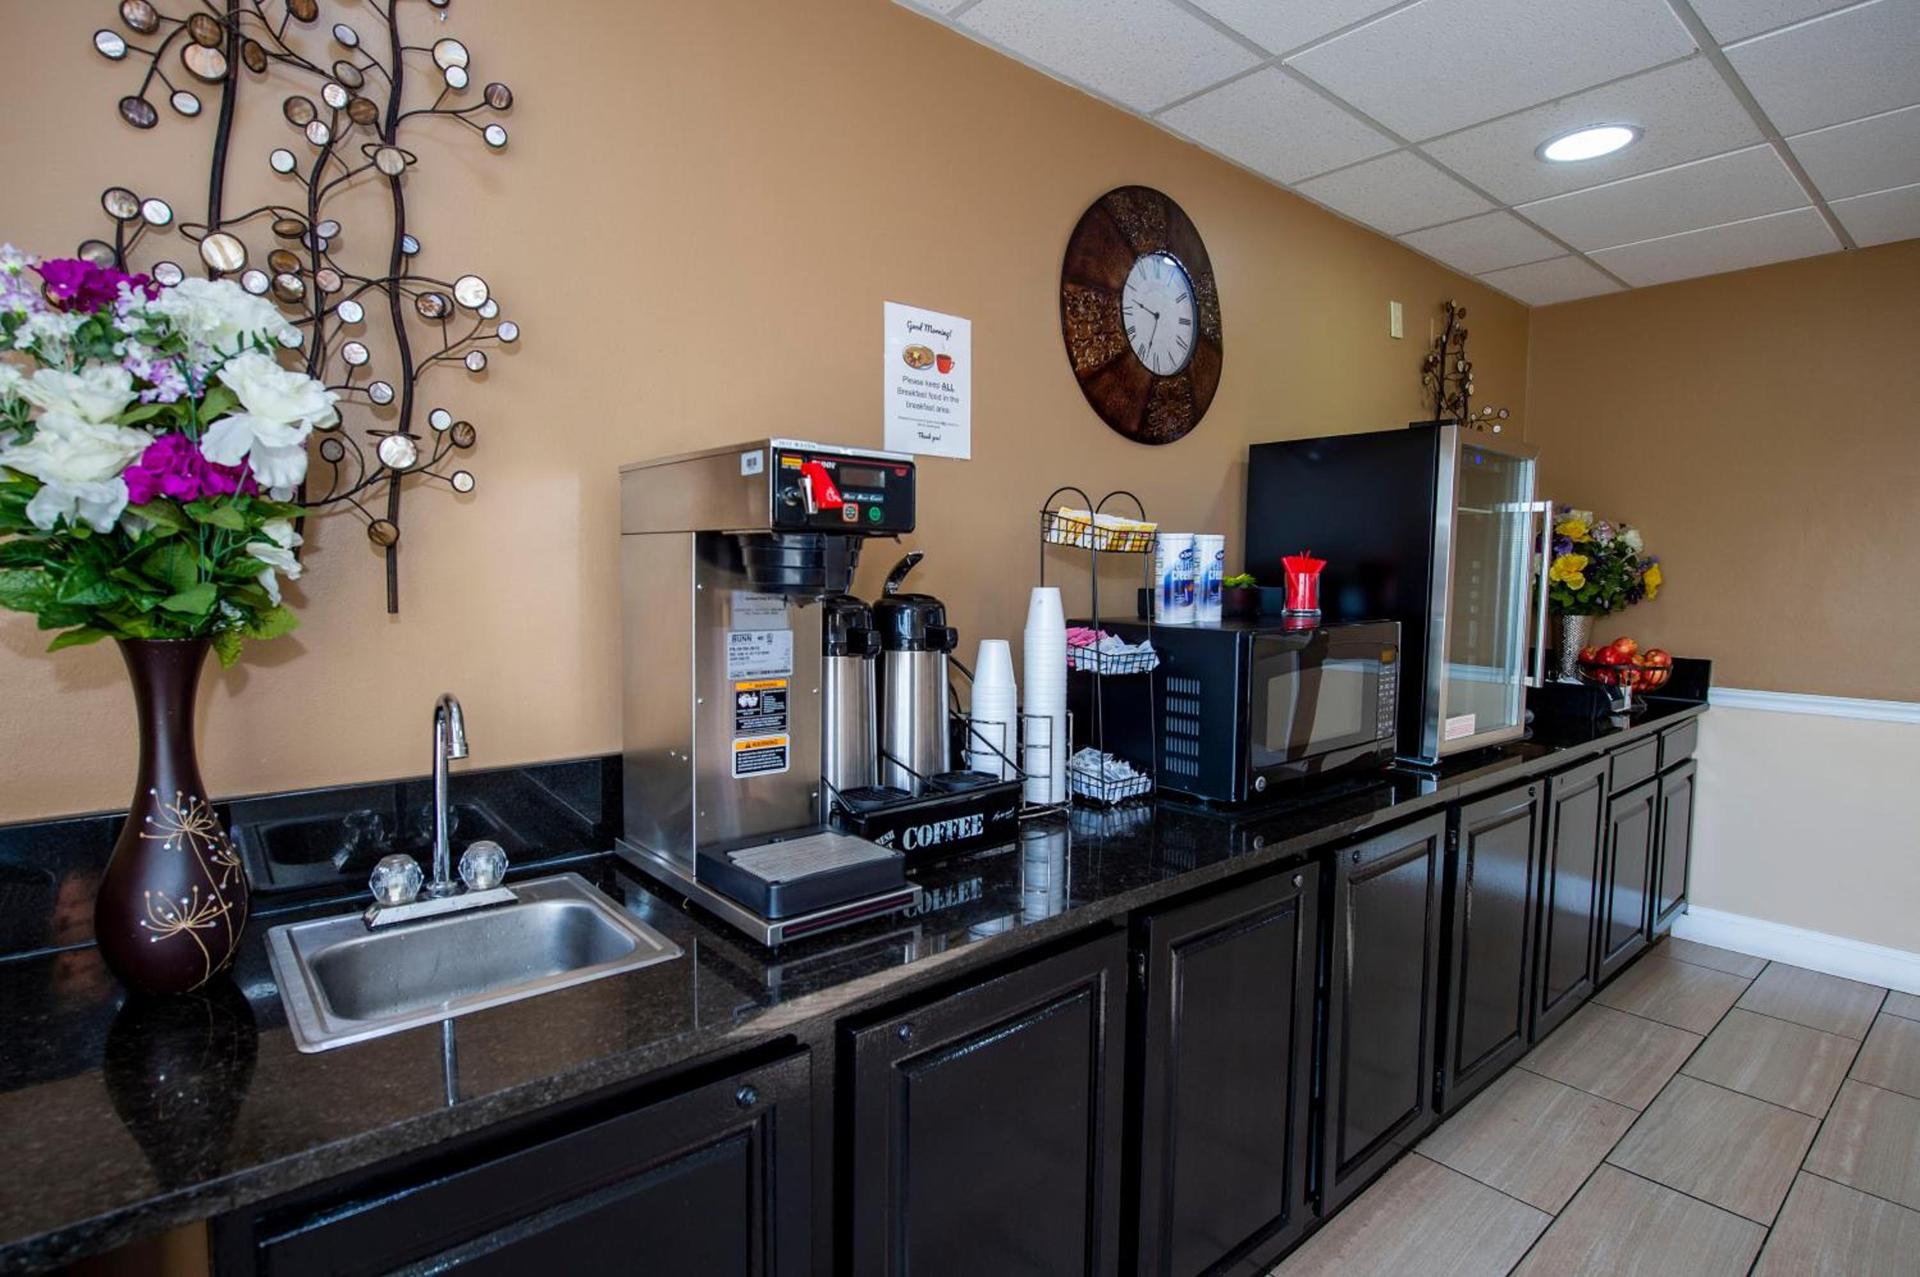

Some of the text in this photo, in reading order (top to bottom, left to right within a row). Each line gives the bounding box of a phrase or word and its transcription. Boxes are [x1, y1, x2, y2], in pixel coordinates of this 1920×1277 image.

[907, 320, 952, 341] Good Morning!
[902, 375, 923, 386] Please
[941, 382, 955, 392] ALL
[897, 386, 928, 399] Breakfast
[928, 390, 942, 402] food
[949, 394, 960, 404] the
[905, 400, 935, 413] breakfast
[917, 432, 932, 441] Thank
[731, 633, 752, 643] BUNN
[902, 813, 984, 851] COFFEE
